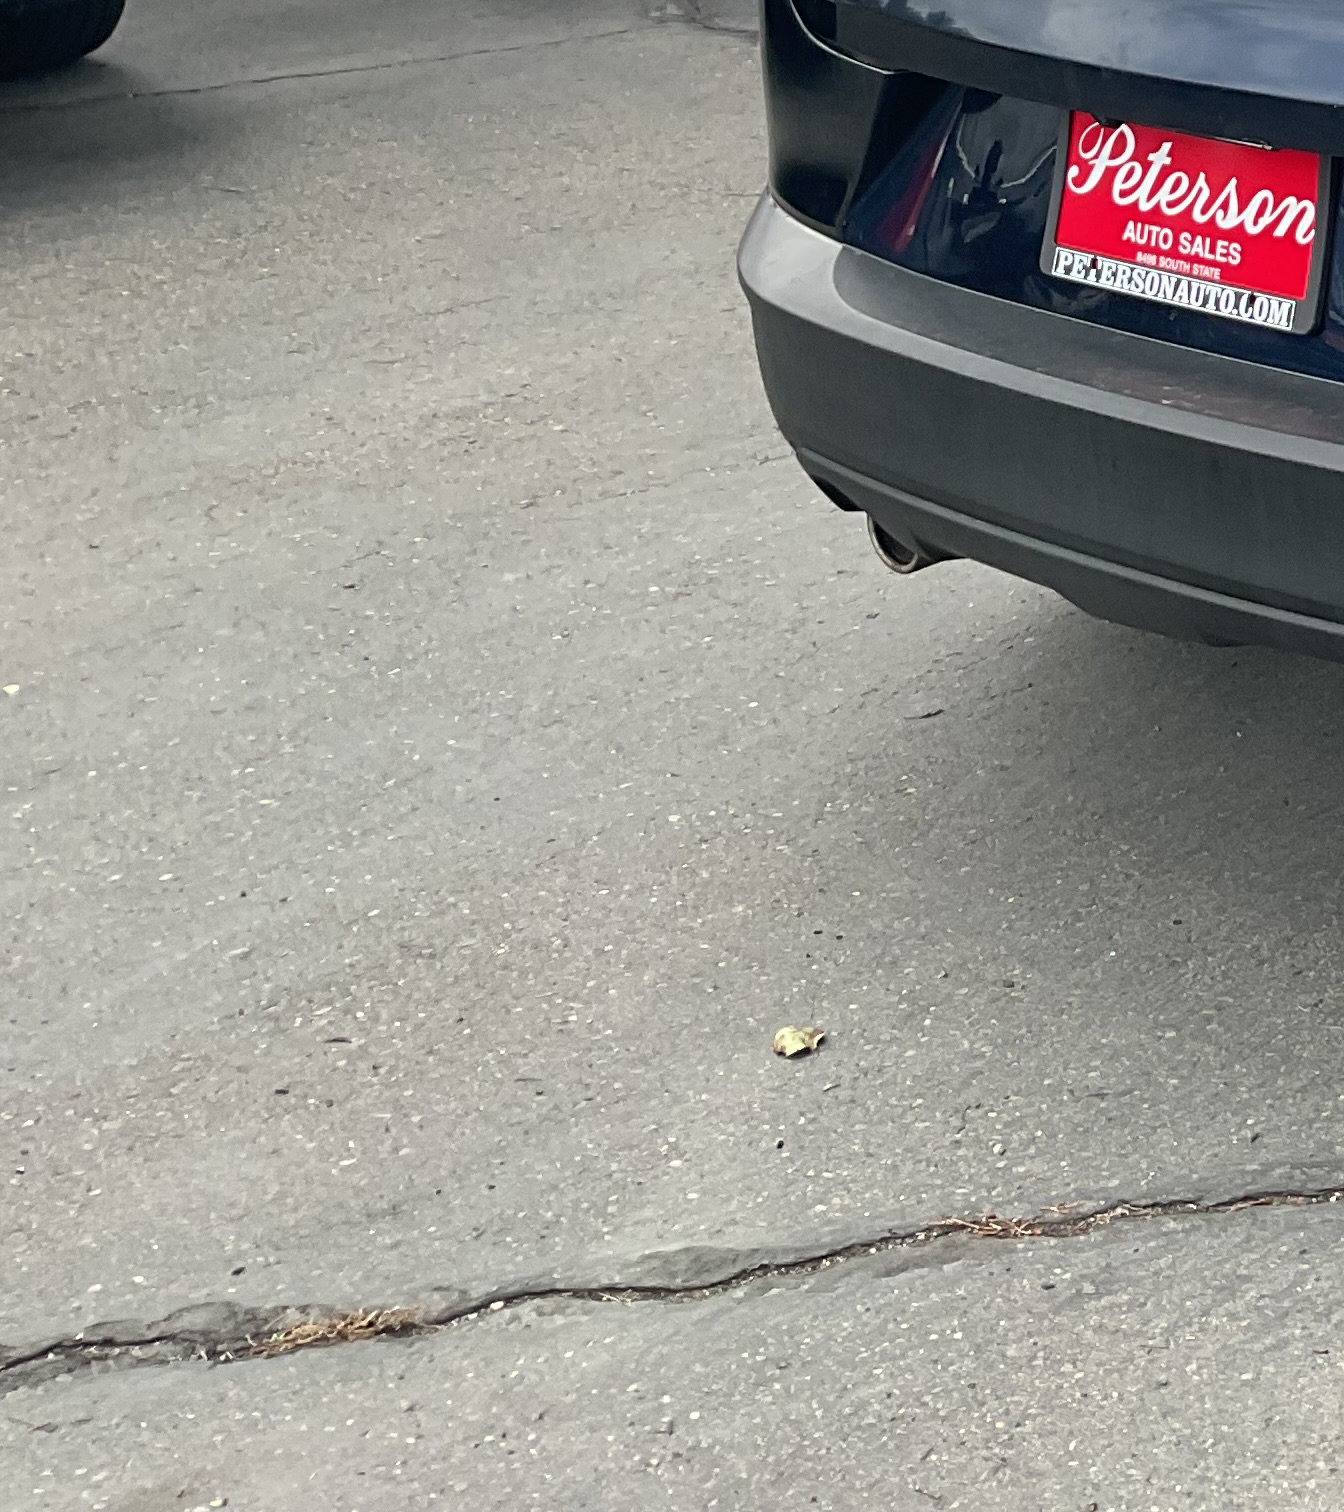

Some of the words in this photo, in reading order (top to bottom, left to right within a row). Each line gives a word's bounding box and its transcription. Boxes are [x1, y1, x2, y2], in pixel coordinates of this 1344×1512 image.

[1067, 121, 1316, 244] Peterson
[1122, 220, 1173, 251] AUTO
[1178, 231, 1242, 265] SALES
[1158, 256, 1190, 273] SOUTH
[1192, 263, 1221, 280] STATE
[1055, 250, 1291, 327] PETERSONAUTO.COM
